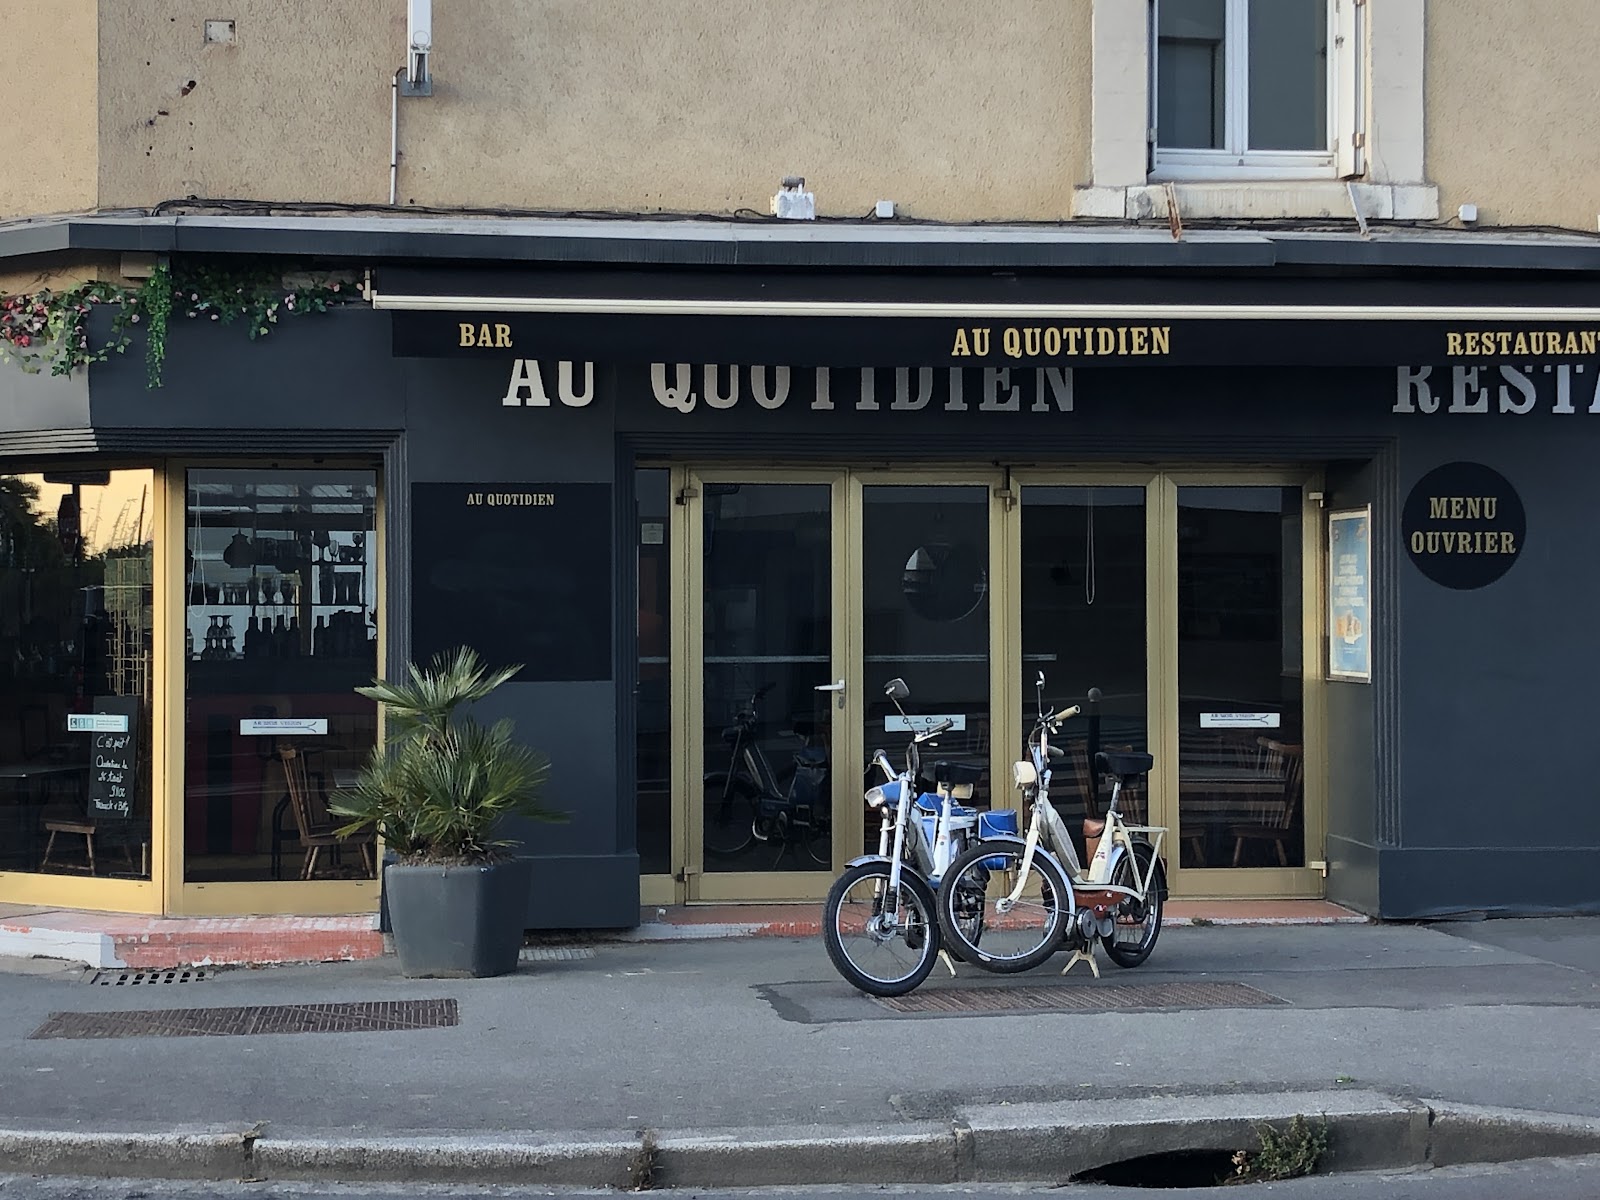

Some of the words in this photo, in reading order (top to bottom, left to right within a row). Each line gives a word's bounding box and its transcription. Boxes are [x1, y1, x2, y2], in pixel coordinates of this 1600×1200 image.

[459, 323, 513, 348] BAR
[951, 328, 990, 356] AU
[1003, 327, 1171, 358] QUOTIDIEN
[1446, 331, 1600, 356] RESTAURAN
[502, 358, 595, 407] AU
[1392, 364, 1600, 415] REST
[466, 493, 484, 506] AU
[487, 493, 555, 507] QUOTIDIEN
[1429, 497, 1497, 519] MENU
[1410, 531, 1516, 554] OUVRIER
